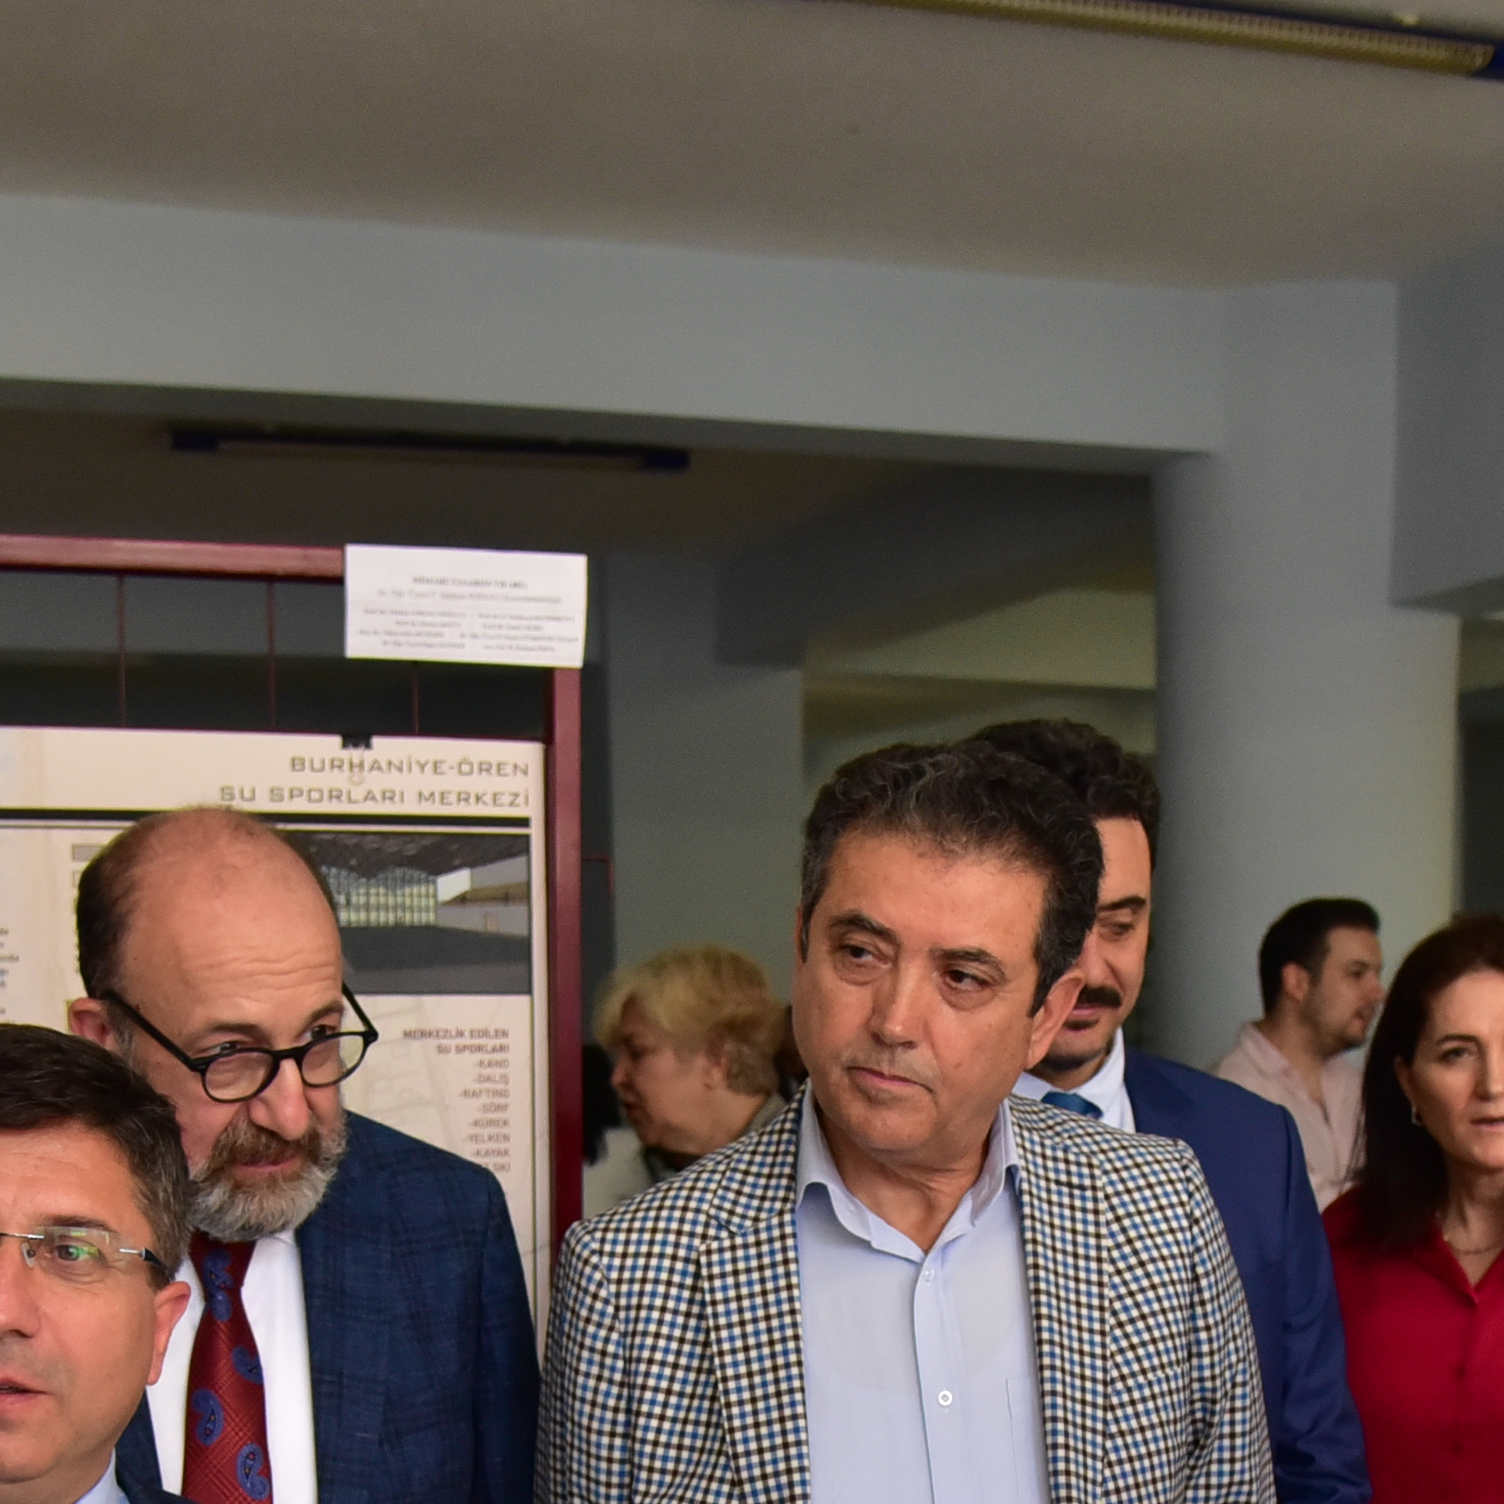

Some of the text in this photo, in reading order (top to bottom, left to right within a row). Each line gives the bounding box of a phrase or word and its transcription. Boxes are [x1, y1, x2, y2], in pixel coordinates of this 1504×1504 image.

[290, 754, 530, 778] BURHANİYE-ÖREN
[219, 785, 531, 808] SU SPORLARI MERKEZİ
[469, 1027, 510, 1040] EDİLEN
